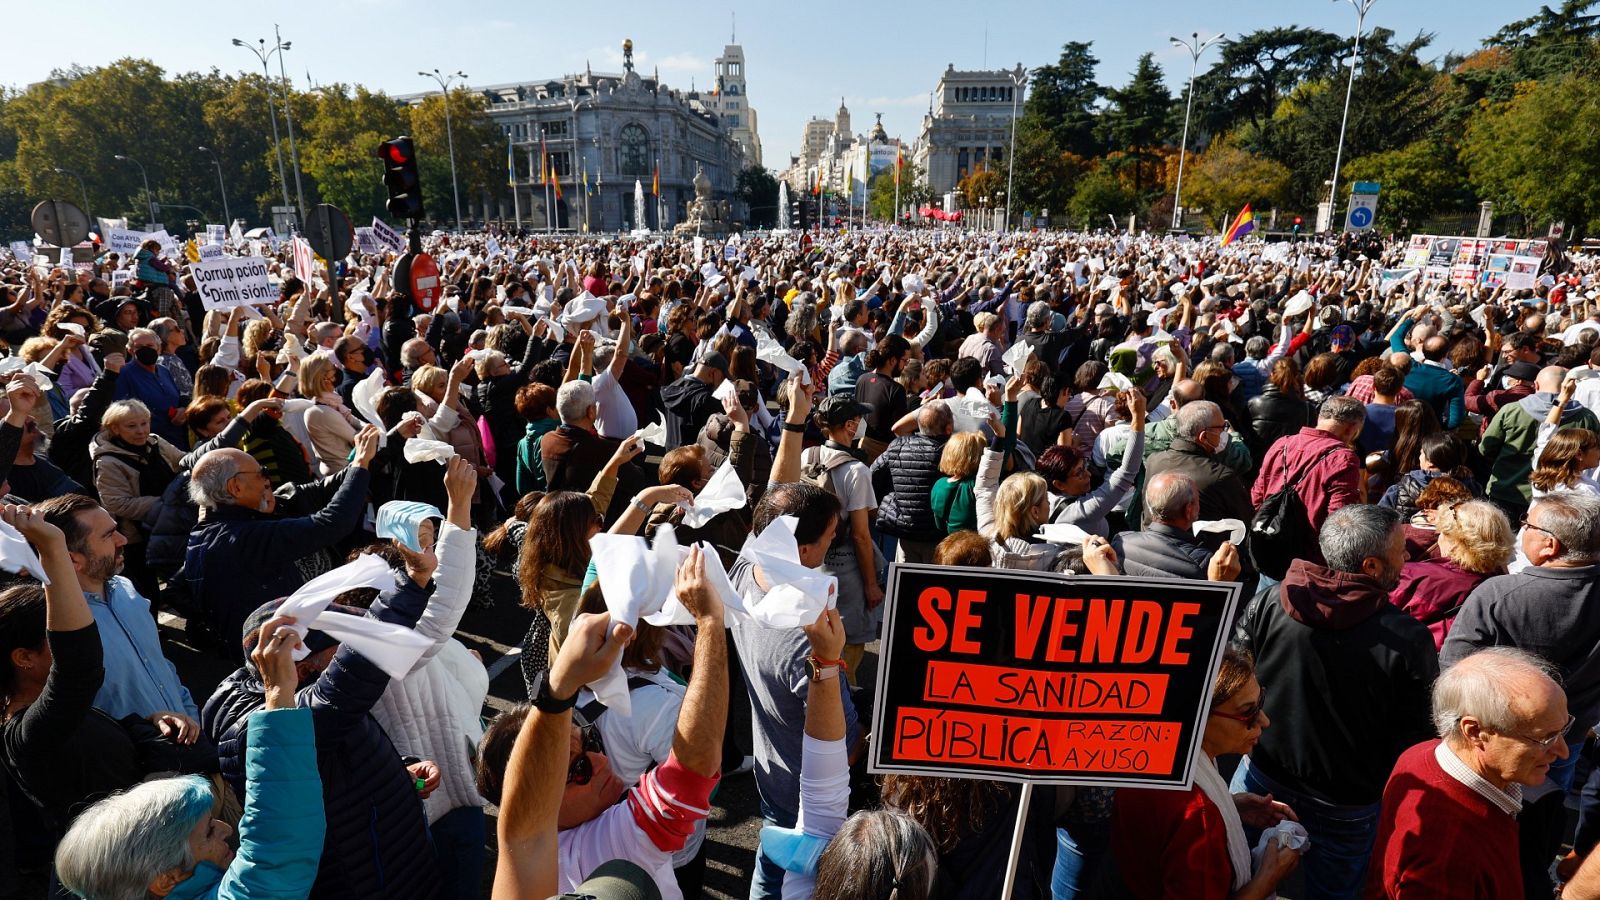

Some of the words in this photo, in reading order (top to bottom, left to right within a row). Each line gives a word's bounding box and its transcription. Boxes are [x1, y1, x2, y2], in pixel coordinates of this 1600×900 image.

[111, 233, 124, 241] Con
[194, 267, 234, 282] Corrup
[235, 262, 267, 281] pción
[209, 286, 239, 302] Dimi
[243, 283, 272, 300] sión!
[913, 586, 987, 654] SE
[1015, 594, 1201, 665] VENDE
[928, 667, 976, 701] LA
[1067, 722, 1171, 743] RAZÓN:
[1062, 747, 1150, 771] AYUSO
